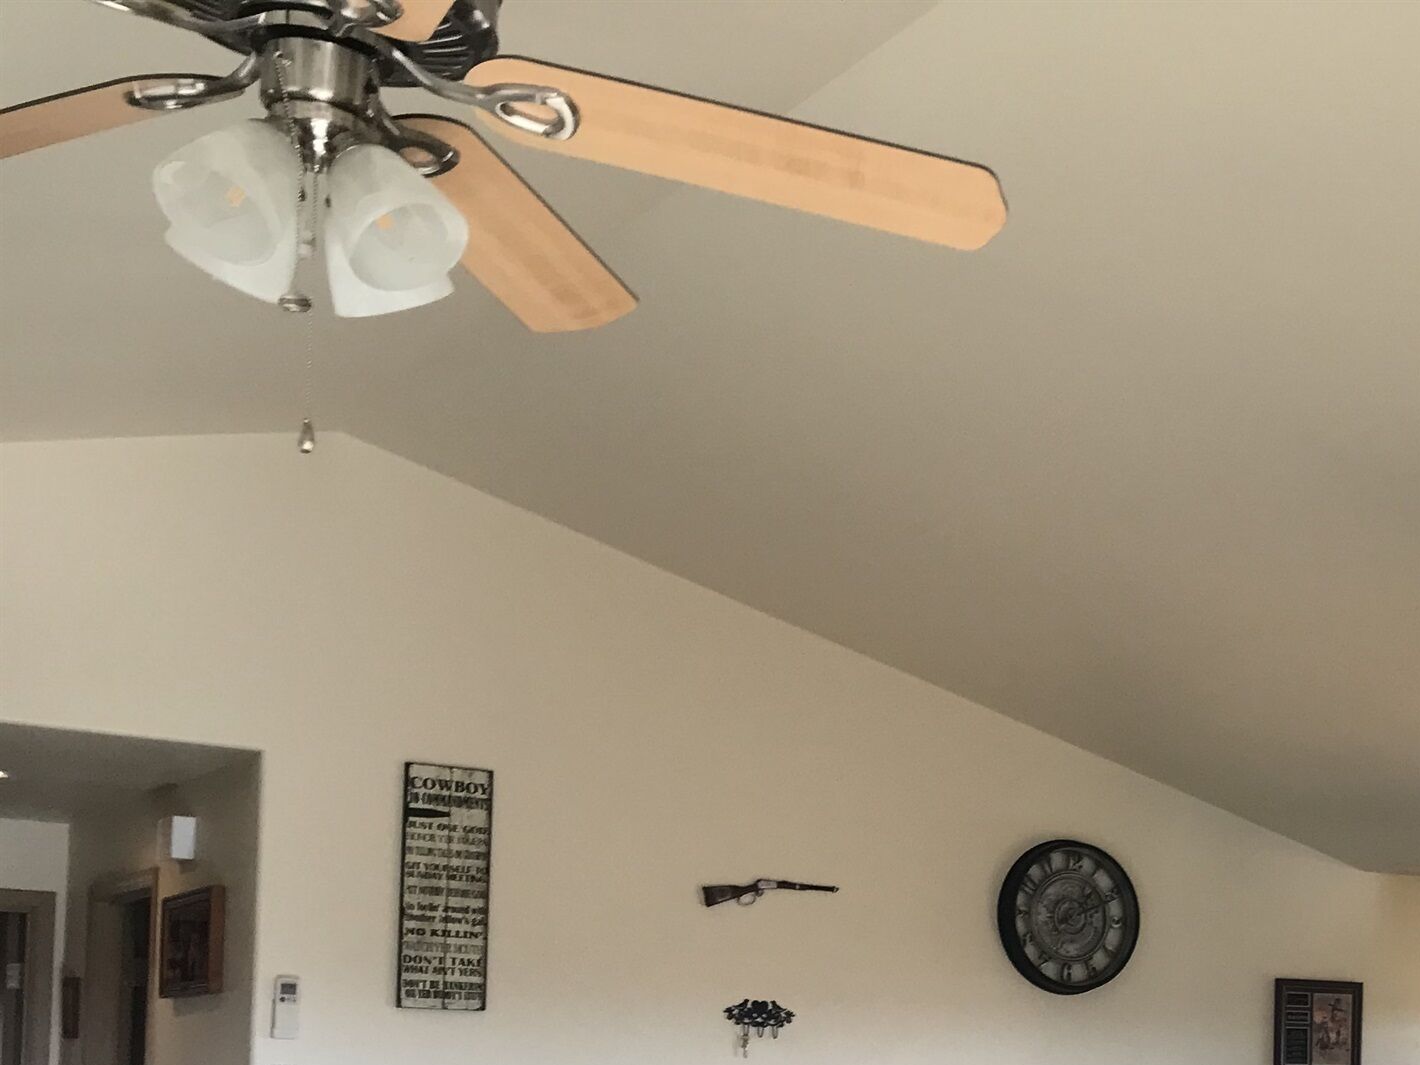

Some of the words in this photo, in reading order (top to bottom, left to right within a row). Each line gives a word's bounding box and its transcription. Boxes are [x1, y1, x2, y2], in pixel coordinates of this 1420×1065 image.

[410, 776, 489, 795] COWBOY
[437, 823, 459, 833] ONE
[404, 927, 426, 936] NO
[402, 955, 444, 966] DON'T
[450, 957, 482, 968] TAKE
